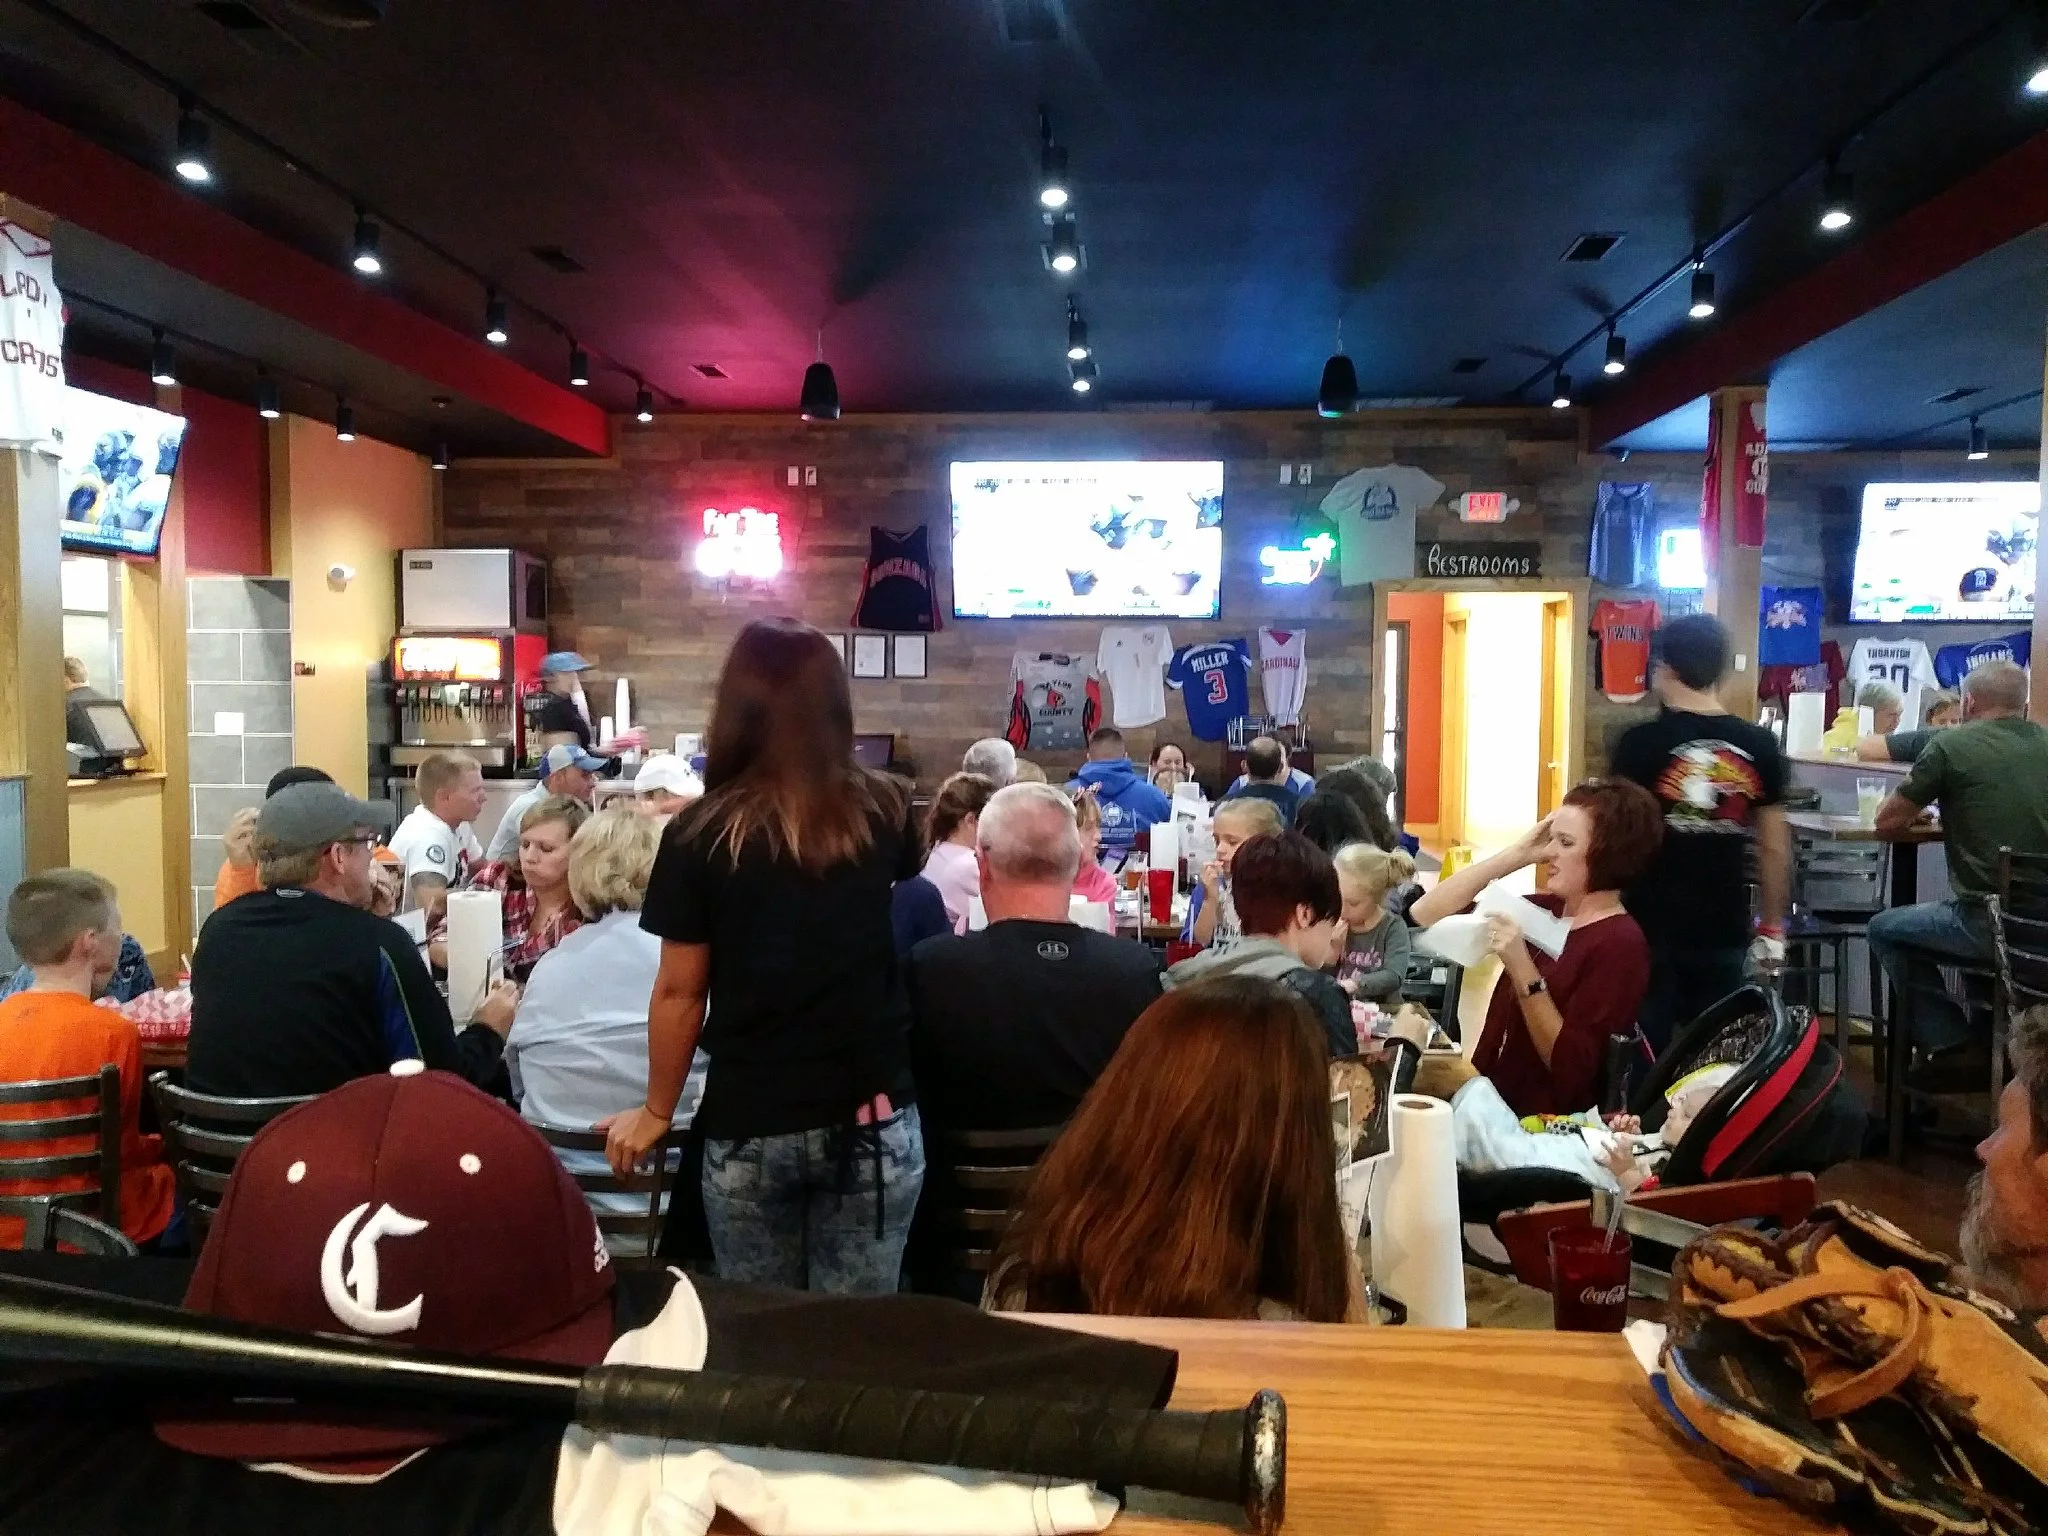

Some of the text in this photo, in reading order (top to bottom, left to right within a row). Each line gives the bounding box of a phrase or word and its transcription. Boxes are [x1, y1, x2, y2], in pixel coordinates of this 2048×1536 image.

[1190, 650, 1229, 673] MILLER
[1867, 647, 1911, 659] THORNTON
[1204, 668, 1229, 705] 3
[321, 1201, 430, 1335] C
